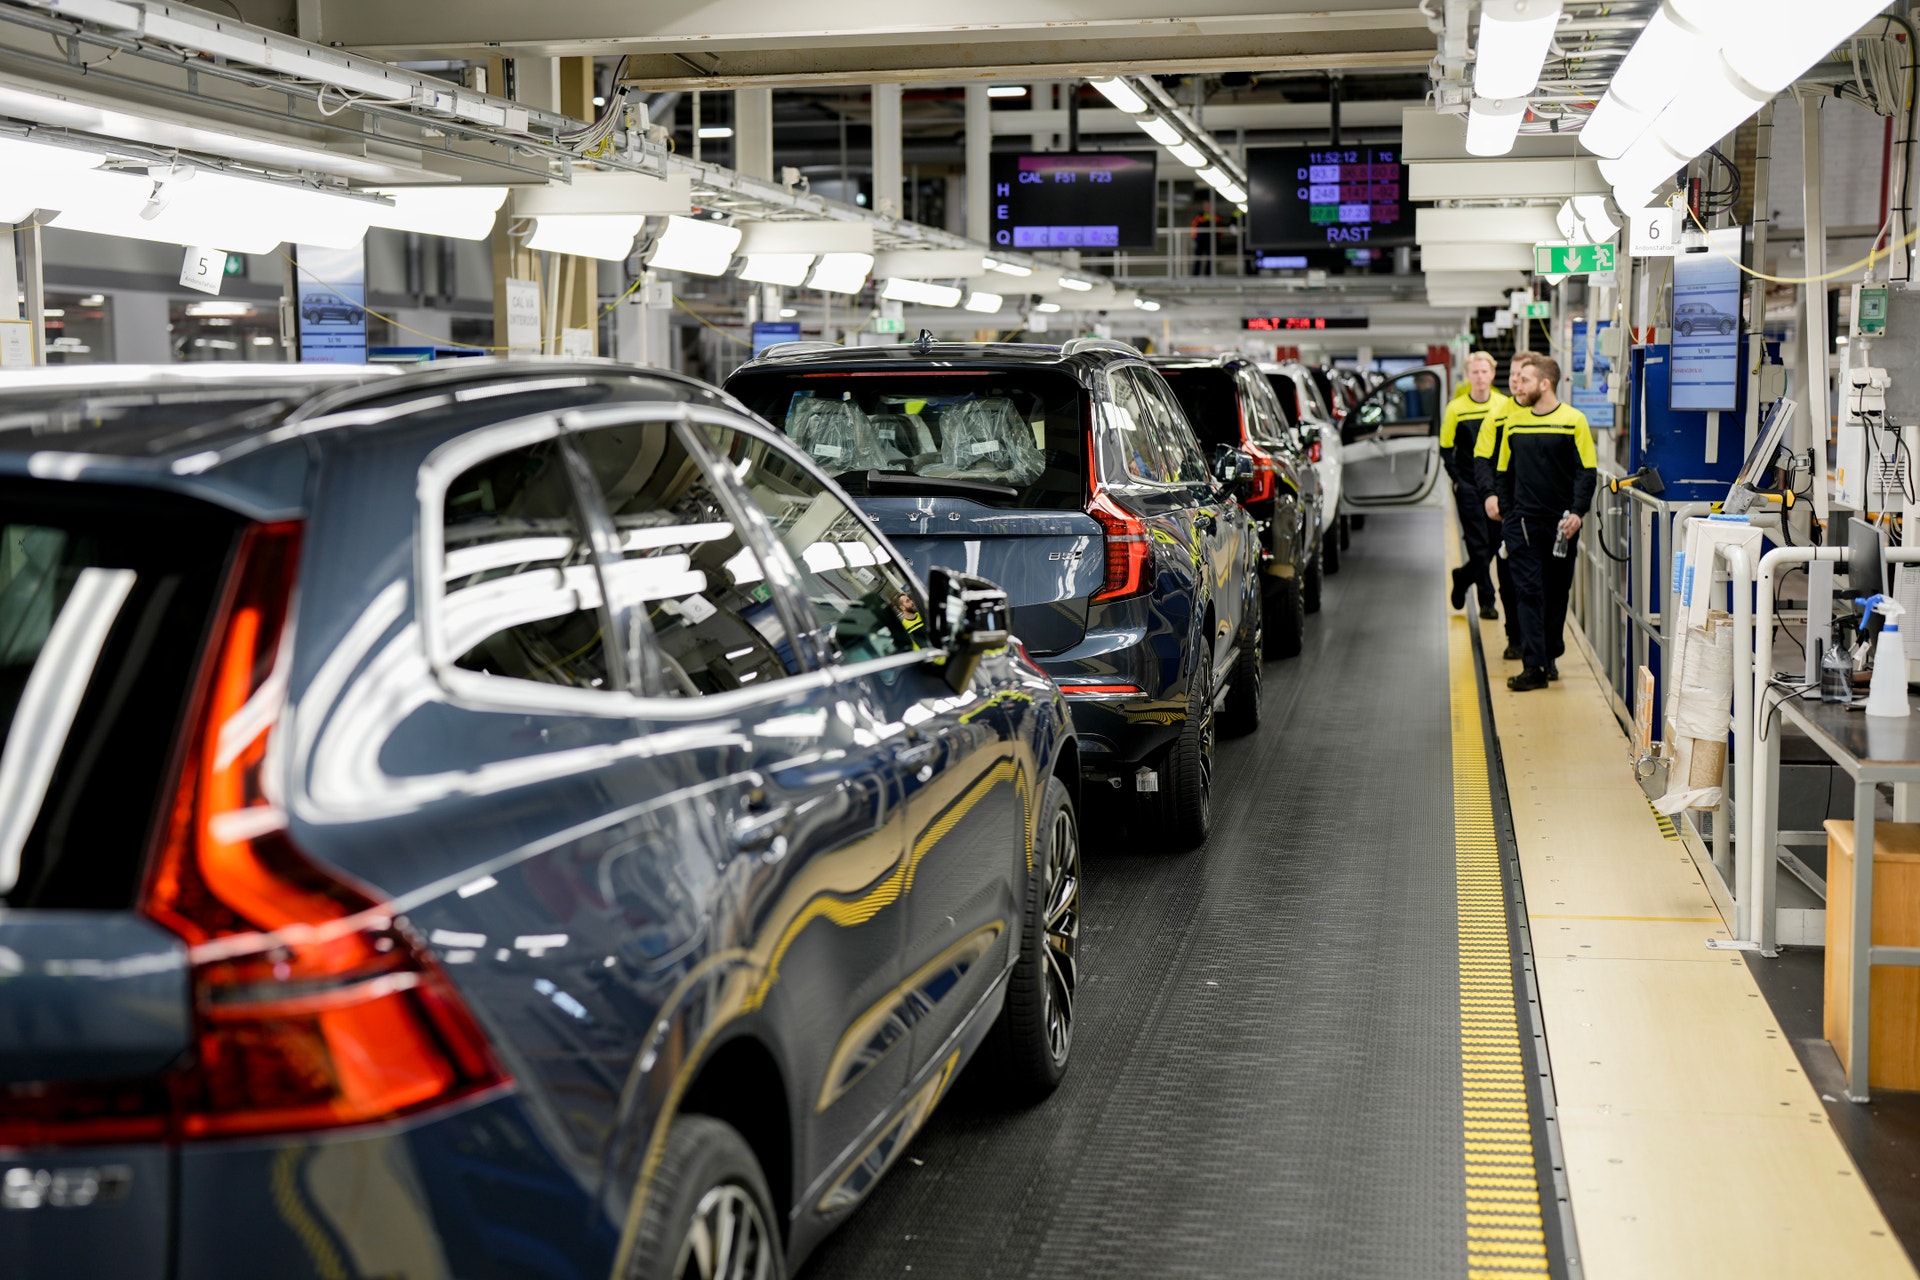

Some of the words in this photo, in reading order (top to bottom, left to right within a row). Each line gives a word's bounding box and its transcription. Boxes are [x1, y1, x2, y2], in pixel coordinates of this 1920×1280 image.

[1309, 152, 1358, 164] 11:52:12
[1379, 152, 1394, 162] TC
[1018, 172, 1043, 183] CAL
[1055, 172, 1076, 183] F51
[1089, 171, 1112, 183] F23
[1297, 167, 1308, 180] D
[997, 183, 1010, 197] H
[1297, 188, 1309, 200] Q
[997, 205, 1009, 219] E
[1327, 227, 1371, 242] RAST
[1649, 219, 1660, 239] 6
[995, 230, 1011, 244] Q
[197, 257, 208, 276] 5
